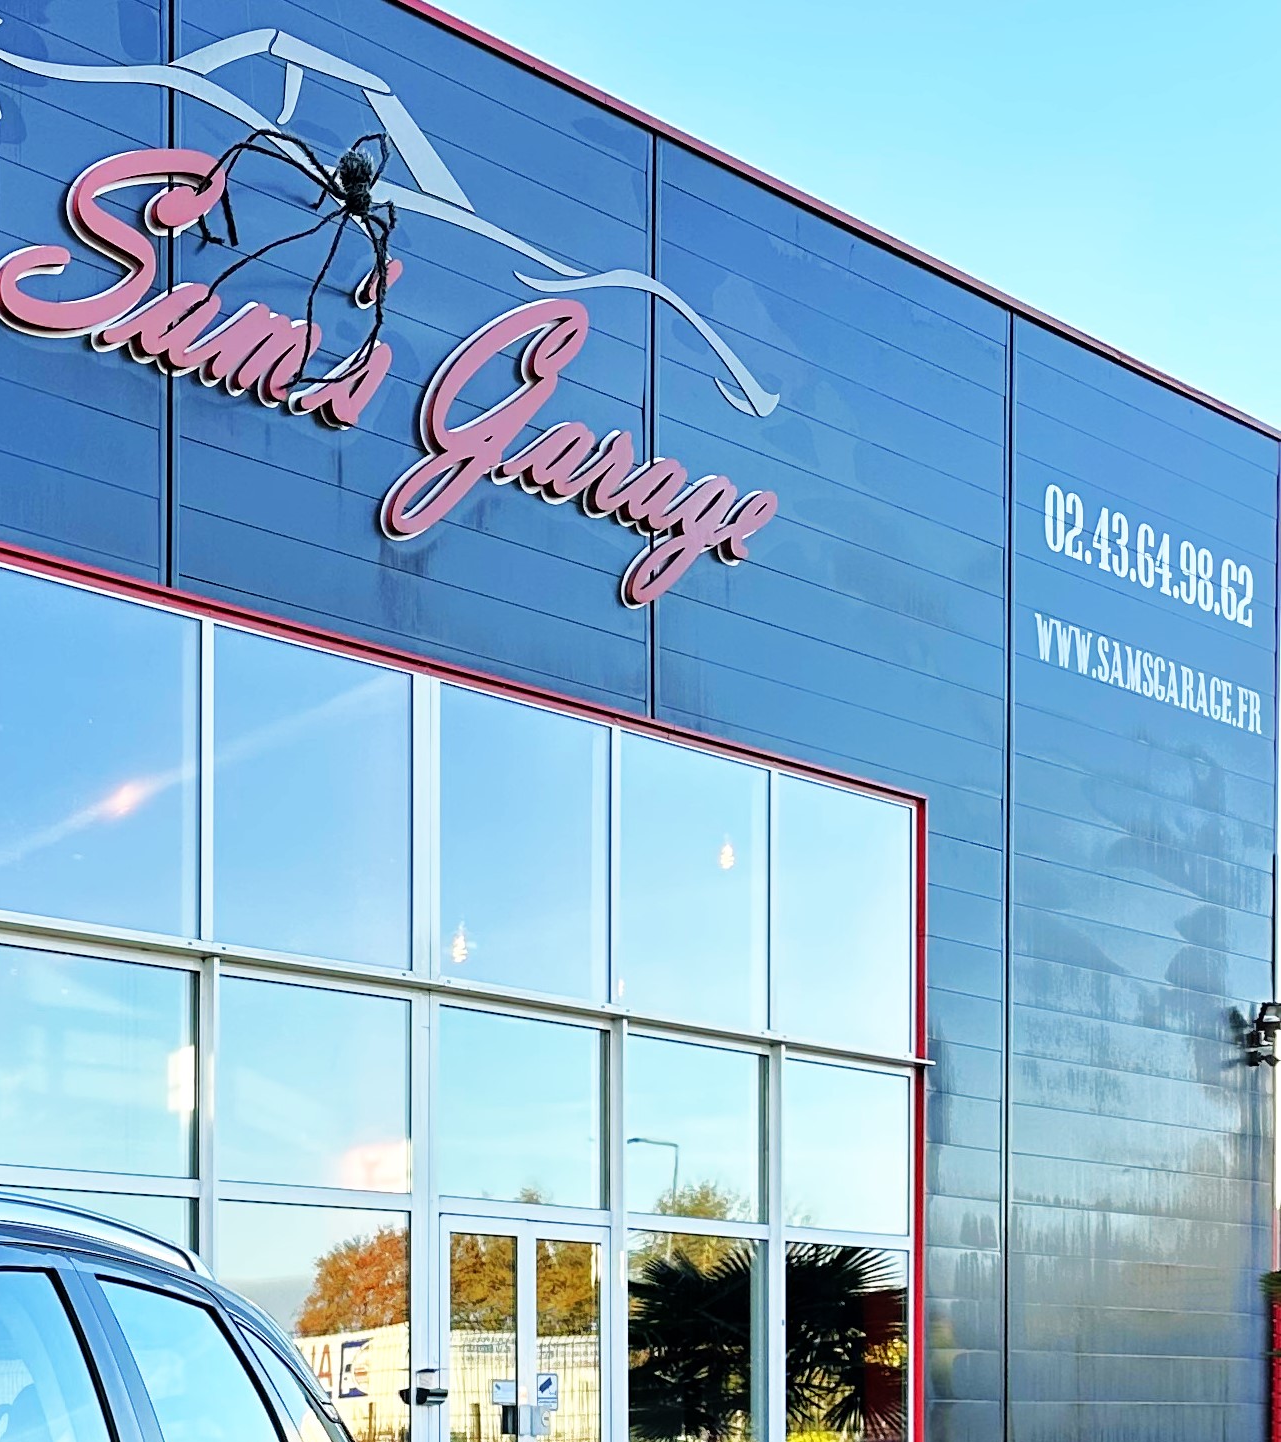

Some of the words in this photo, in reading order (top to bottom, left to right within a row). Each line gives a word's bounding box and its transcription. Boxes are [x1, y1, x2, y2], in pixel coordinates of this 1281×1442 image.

[380, 297, 778, 609] Garage
[1044, 484, 1254, 628] 02.43.64.98.62
[1034, 612, 1262, 735] WWW.SAMSGARAGE.FR
